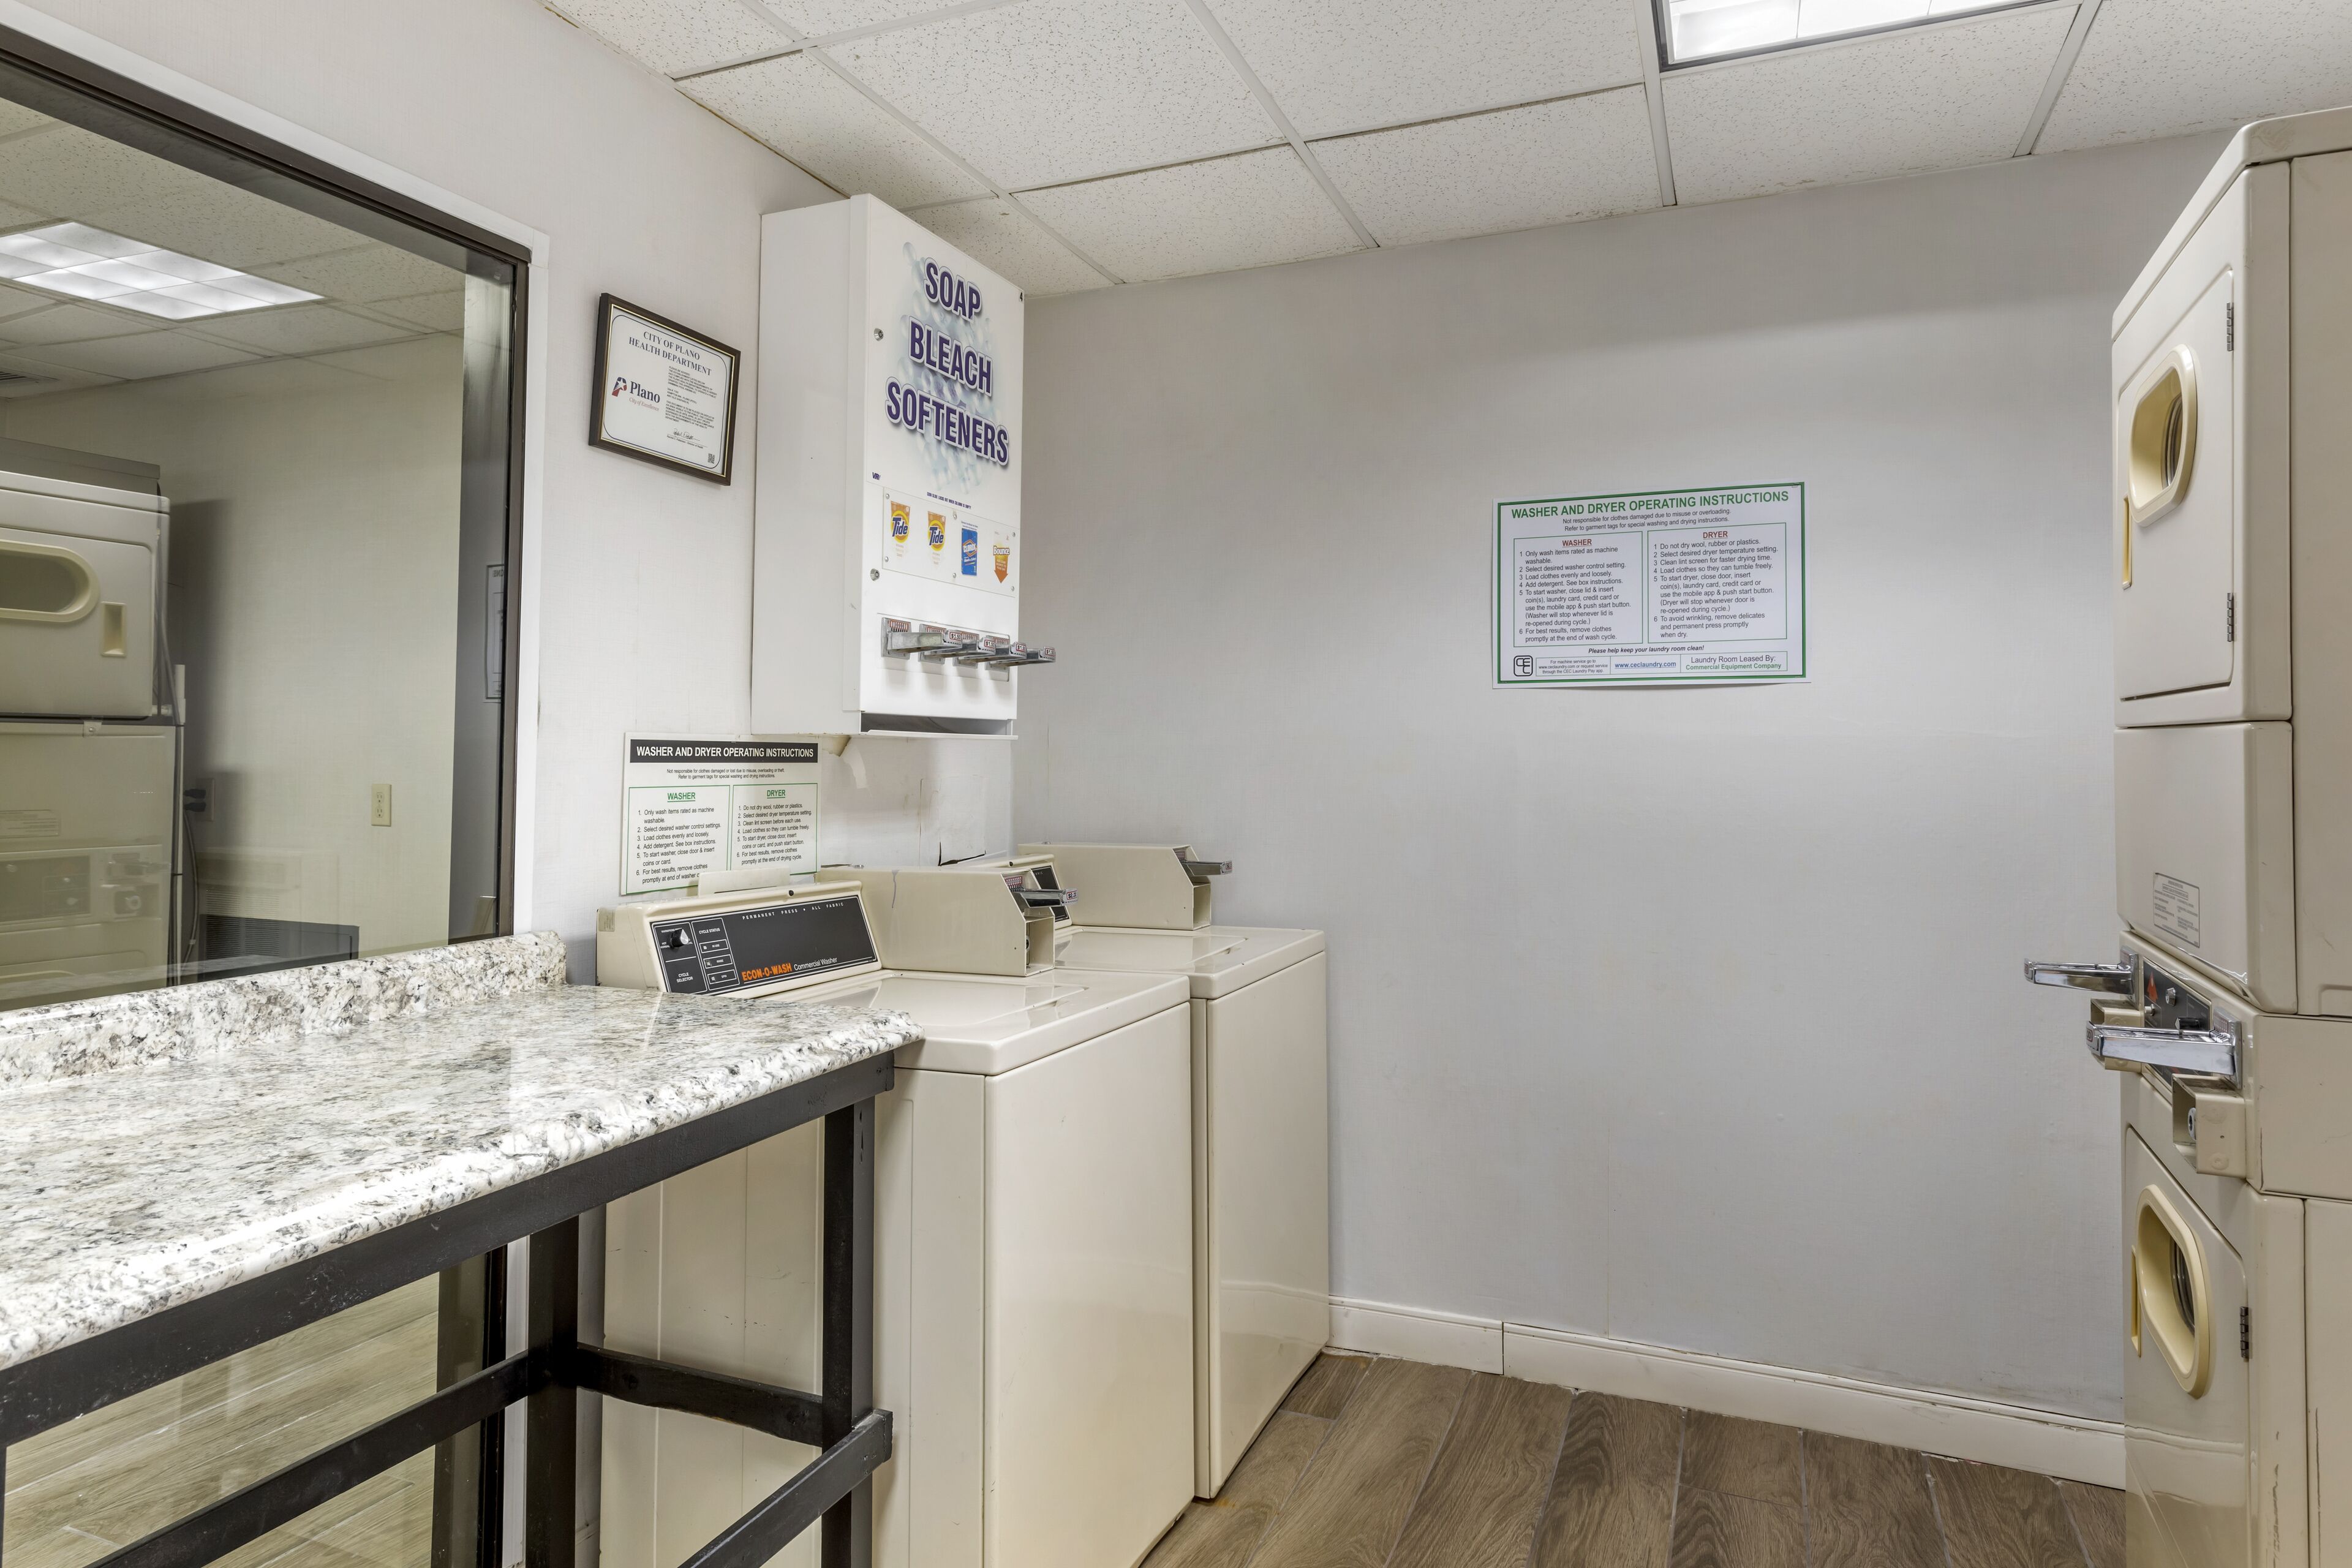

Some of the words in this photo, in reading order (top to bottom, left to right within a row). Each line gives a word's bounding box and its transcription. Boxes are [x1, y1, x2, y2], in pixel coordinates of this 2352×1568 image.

[925, 263, 981, 319] SOAP
[628, 336, 660, 355] HEALTH
[662, 350, 711, 375] DEPARTMENT
[643, 331, 662, 344] CITY
[663, 339, 674, 349] OF
[675, 344, 699, 360] PLANO
[910, 320, 991, 393] BLEACH
[630, 381, 660, 403] Plano
[641, 400, 659, 412] Excellence
[888, 382, 1008, 464] SOFTENERS
[1511, 506, 1558, 518] WASHER
[1561, 504, 1584, 515] AND
[1588, 501, 1626, 513] DRYER
[1629, 496, 1695, 511] OPERATING
[1700, 491, 1789, 506] INSTRUCTIONS
[892, 517, 908, 537] Tide
[929, 527, 944, 545] Tide
[993, 546, 1010, 556] Bounce
[1765, 654, 1776, 663] By:
[636, 746, 673, 756] WASHER
[674, 747, 693, 756] AND
[695, 747, 722, 756] DRYER
[723, 747, 764, 756] OPERATING
[766, 748, 813, 757] INSTRUCTIONS
[742, 963, 792, 981] ECON-O-WASH
[793, 959, 821, 970] Commercial
